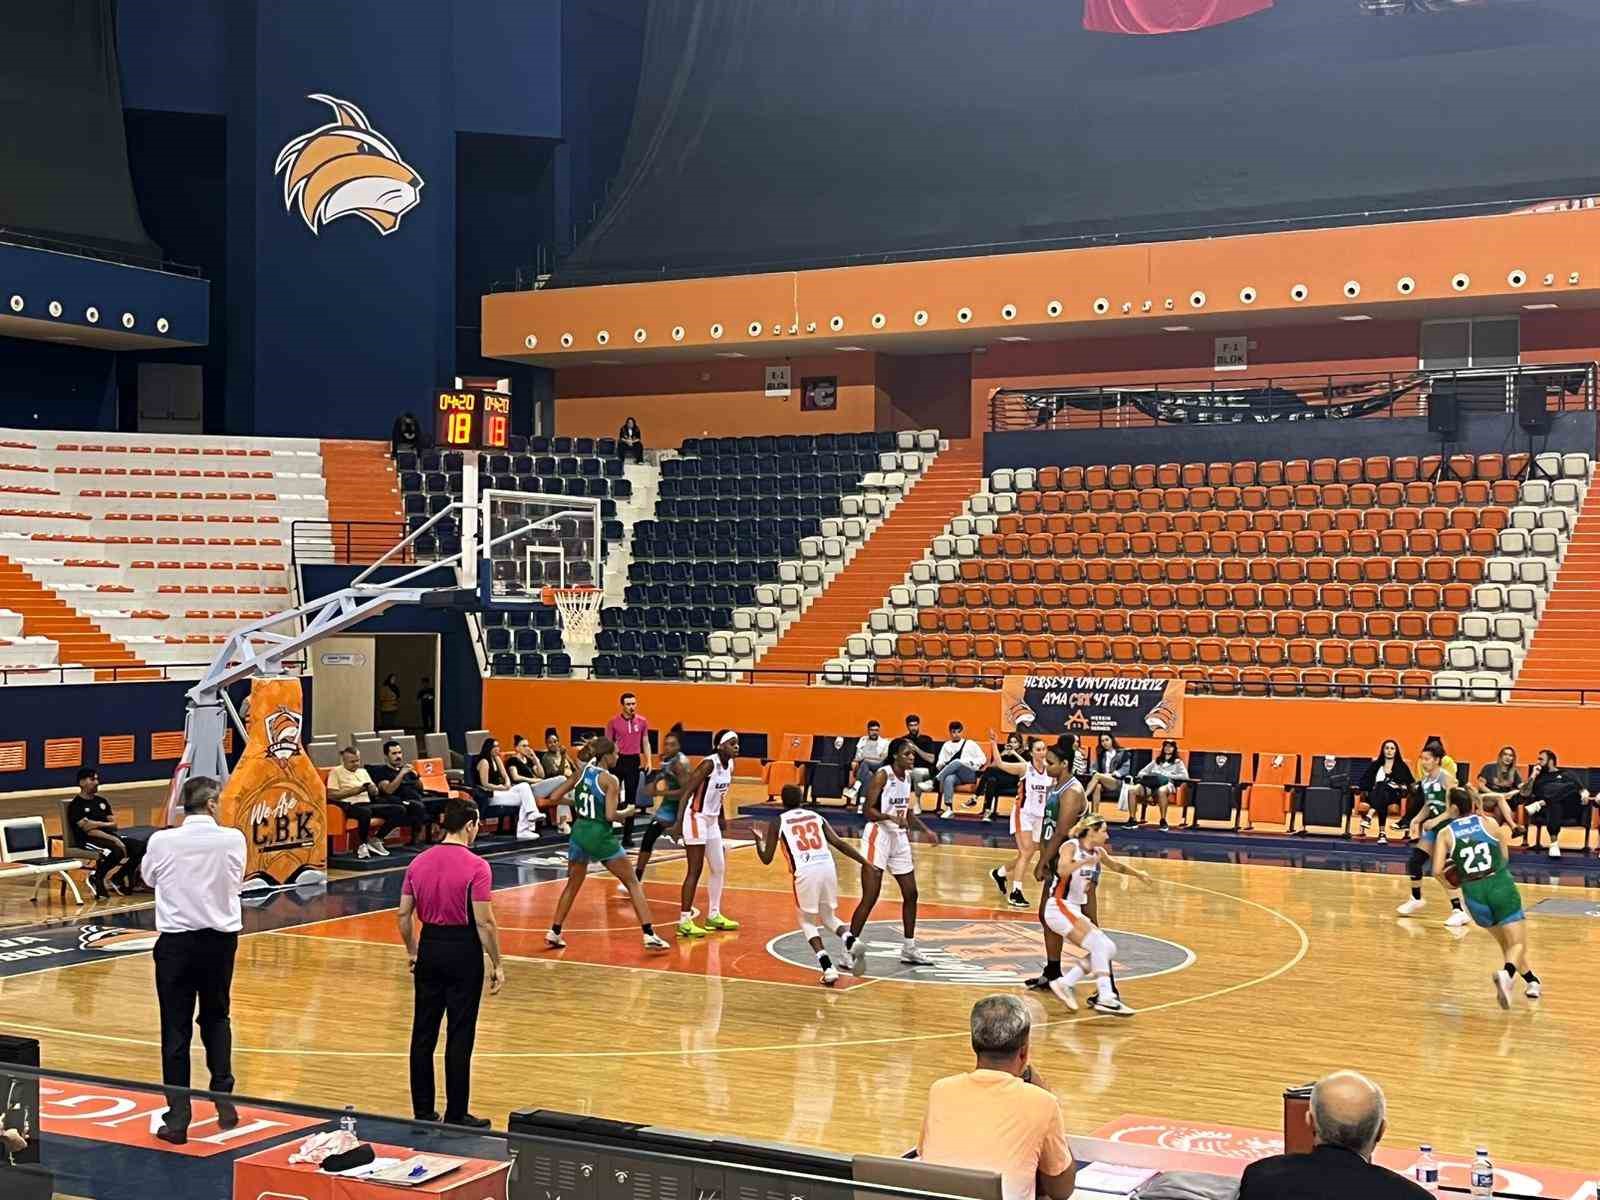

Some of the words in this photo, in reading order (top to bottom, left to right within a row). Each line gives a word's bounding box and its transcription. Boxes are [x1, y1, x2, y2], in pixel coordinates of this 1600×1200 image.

[448, 413, 471, 444] 18
[488, 415, 506, 447] 18
[1042, 692, 1068, 705] AMA
[1110, 694, 1139, 707] ASLA
[579, 792, 596, 819] 31
[791, 822, 822, 851] 33
[1460, 842, 1492, 874] 23
